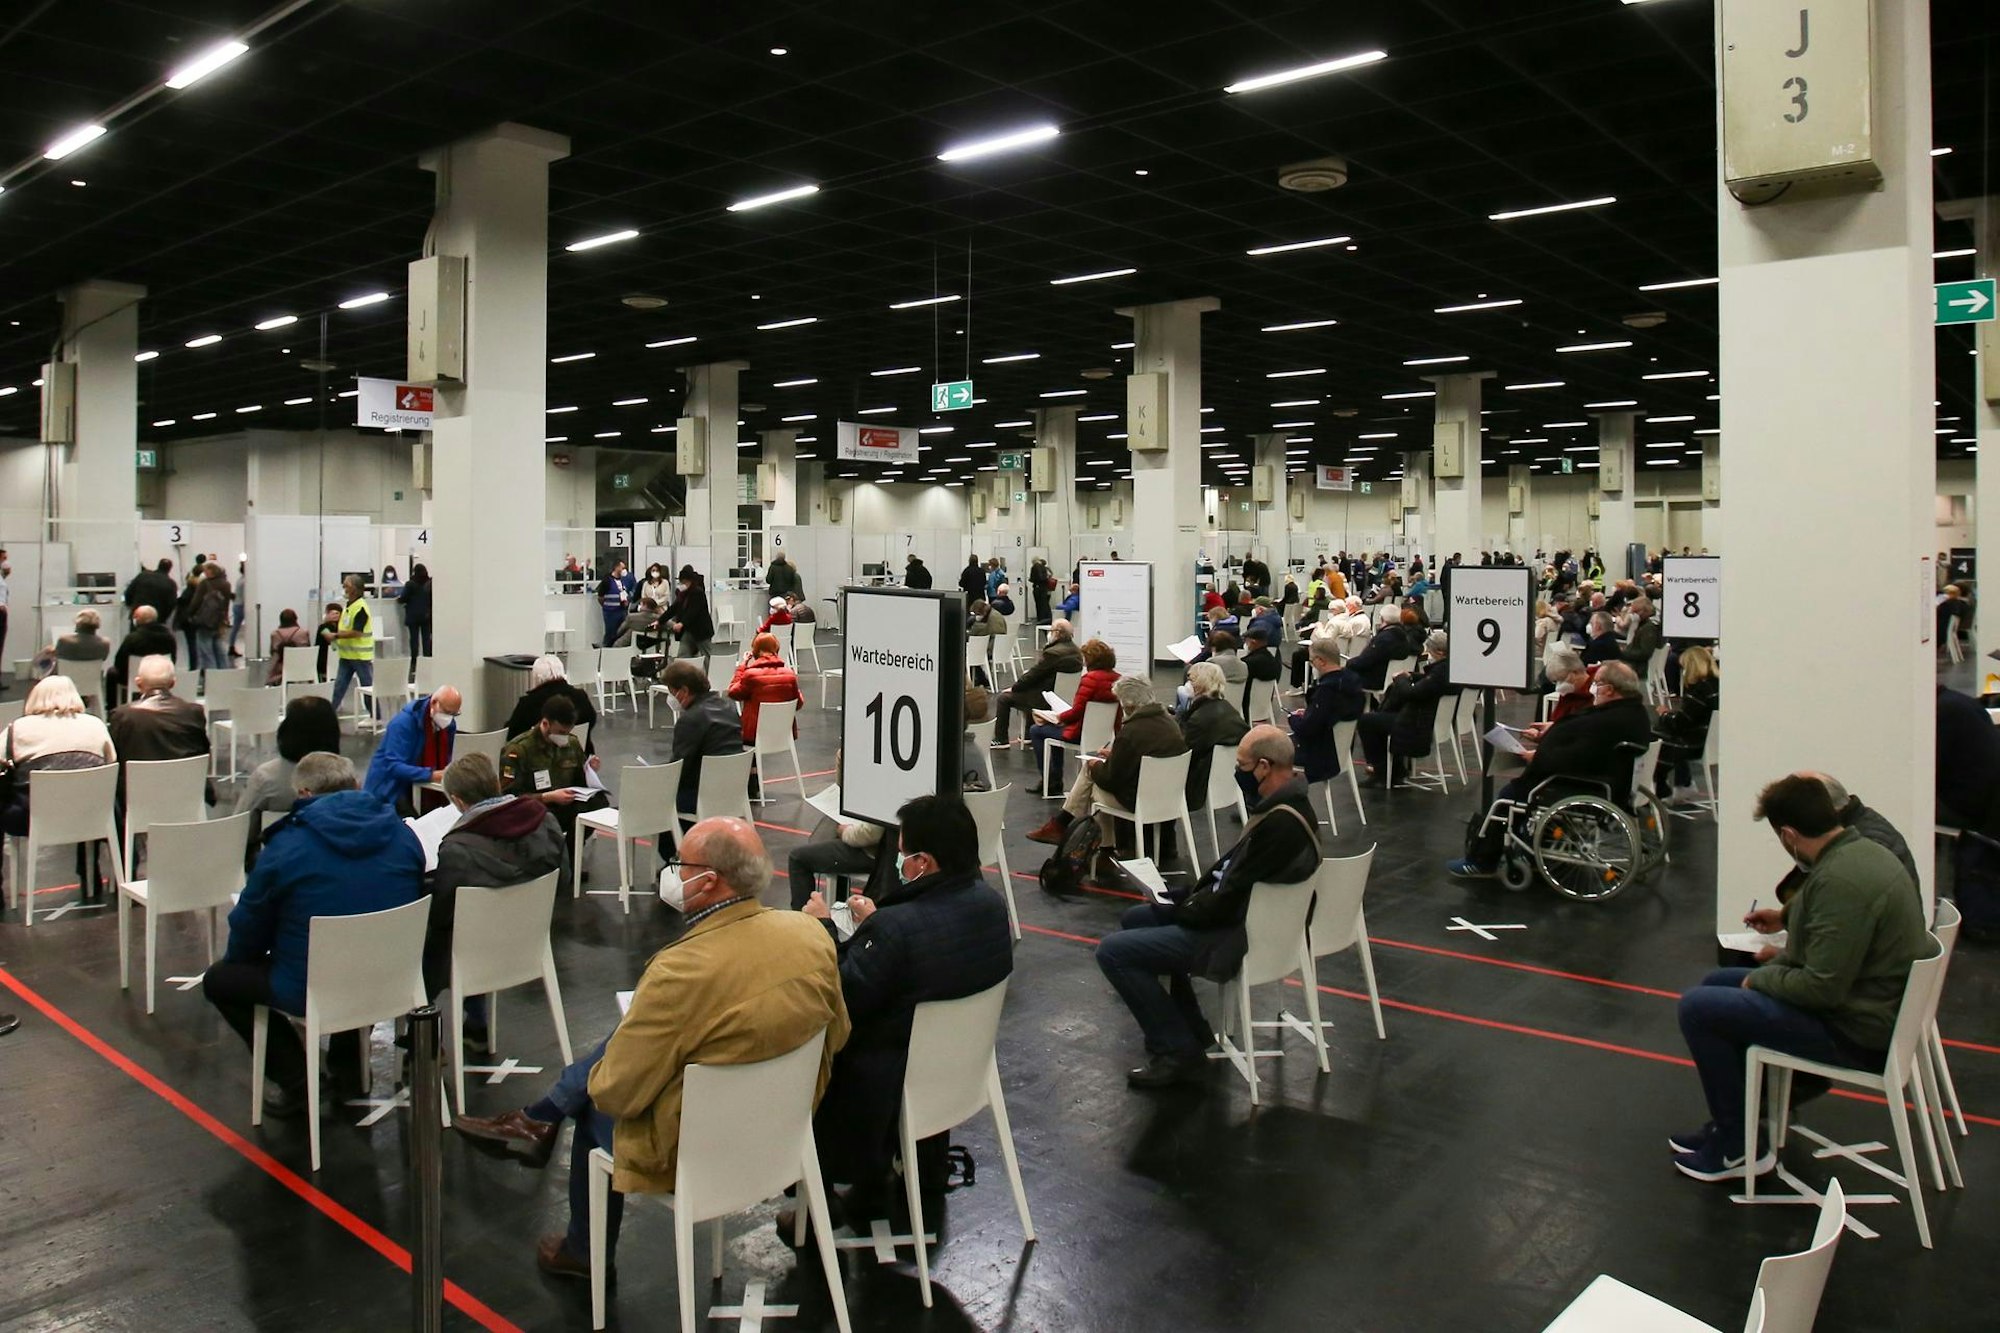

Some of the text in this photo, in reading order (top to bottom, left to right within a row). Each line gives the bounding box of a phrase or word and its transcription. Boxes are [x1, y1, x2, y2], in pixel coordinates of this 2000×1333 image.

[1785, 9, 1808, 58] J
[1783, 77, 1808, 123] 3
[371, 411, 430, 428] Registrierung
[1138, 406, 1147, 419] K
[170, 525, 182, 543] 3
[417, 530, 428, 545] 4
[616, 532, 624, 546] 5
[775, 534, 782, 546] 6
[906, 535, 913, 547] 7
[1016, 536, 1022, 547] 8
[1108, 537, 1113, 547] 9
[1958, 560, 1969, 574] 4
[1667, 576, 1718, 584] Wartebereich
[1455, 595, 1525, 607] Wartebereich
[1683, 591, 1700, 618] 8
[1477, 618, 1501, 657] 9
[851, 645, 934, 671] Wartebereich
[866, 691, 922, 771] 10
